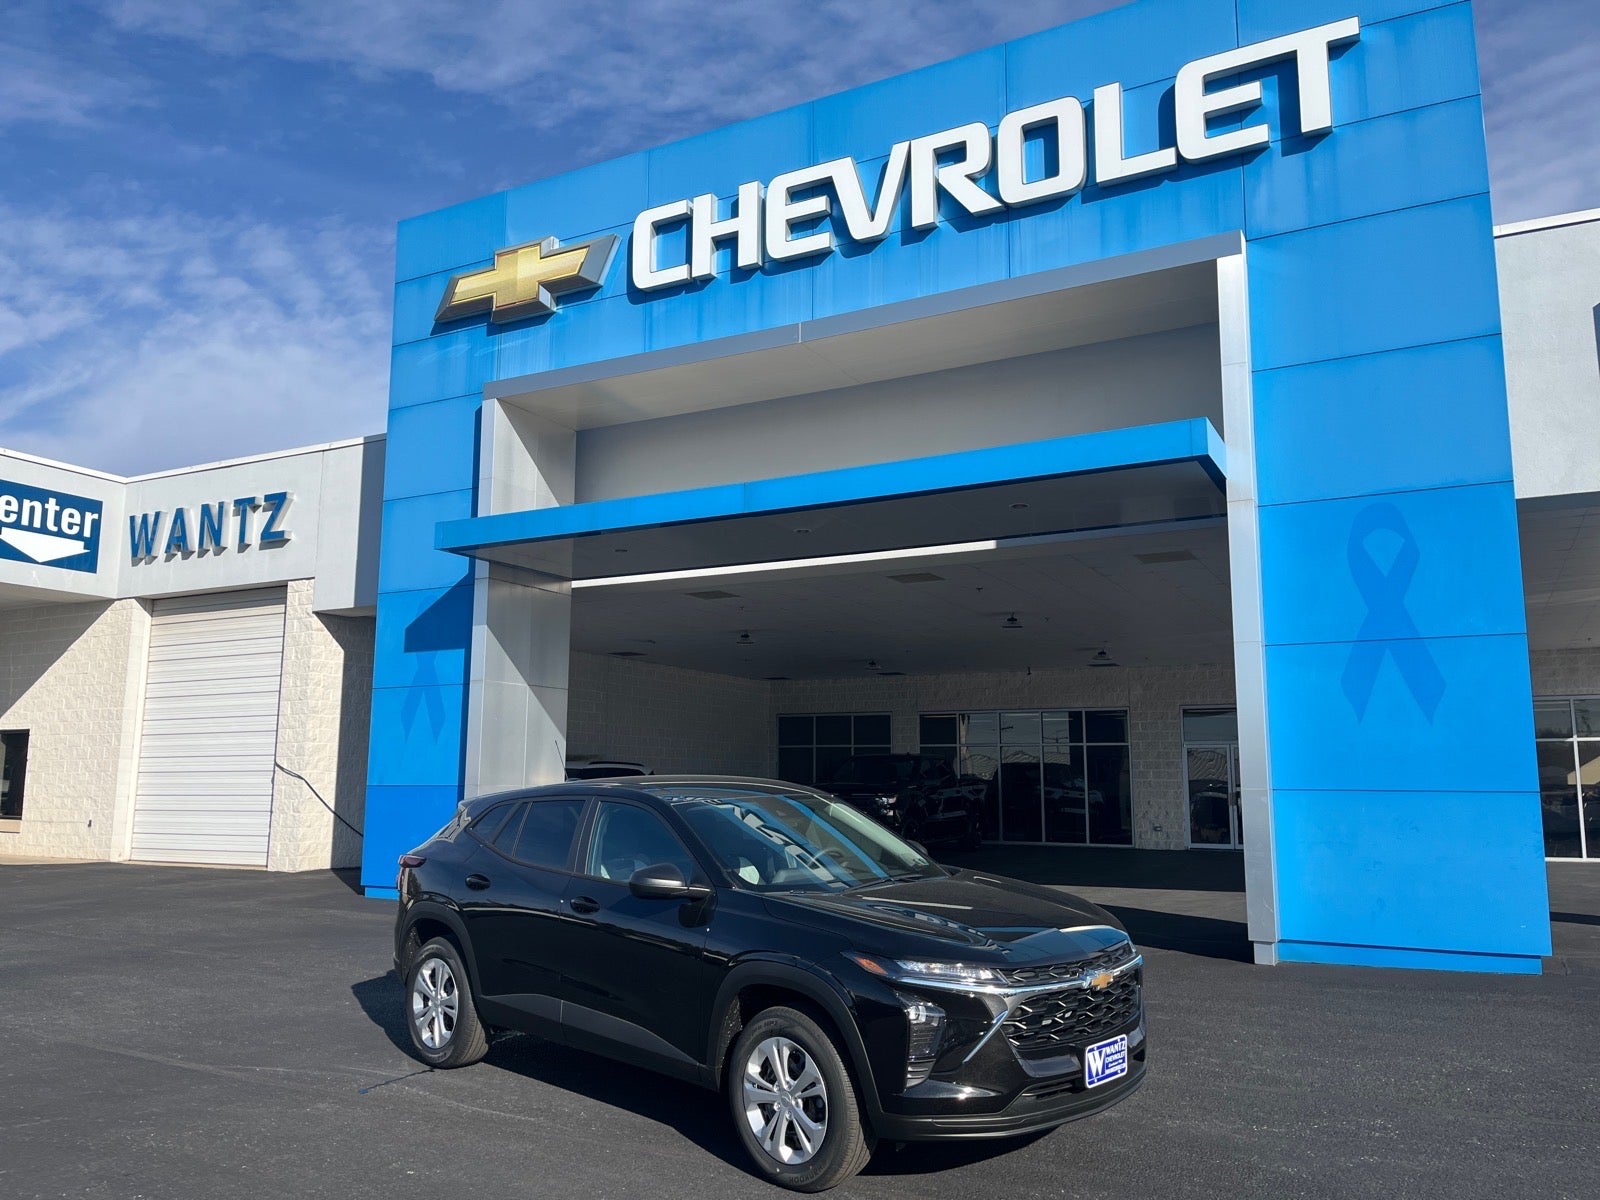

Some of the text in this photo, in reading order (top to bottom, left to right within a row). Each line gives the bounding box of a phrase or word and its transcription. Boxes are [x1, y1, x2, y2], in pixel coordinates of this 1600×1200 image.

[631, 16, 1360, 292] CHEVROLET
[0, 494, 99, 538] enter
[129, 491, 292, 566] WANTZ
[1087, 1048, 1106, 1079] W
[1105, 1041, 1126, 1055] WANTZ
